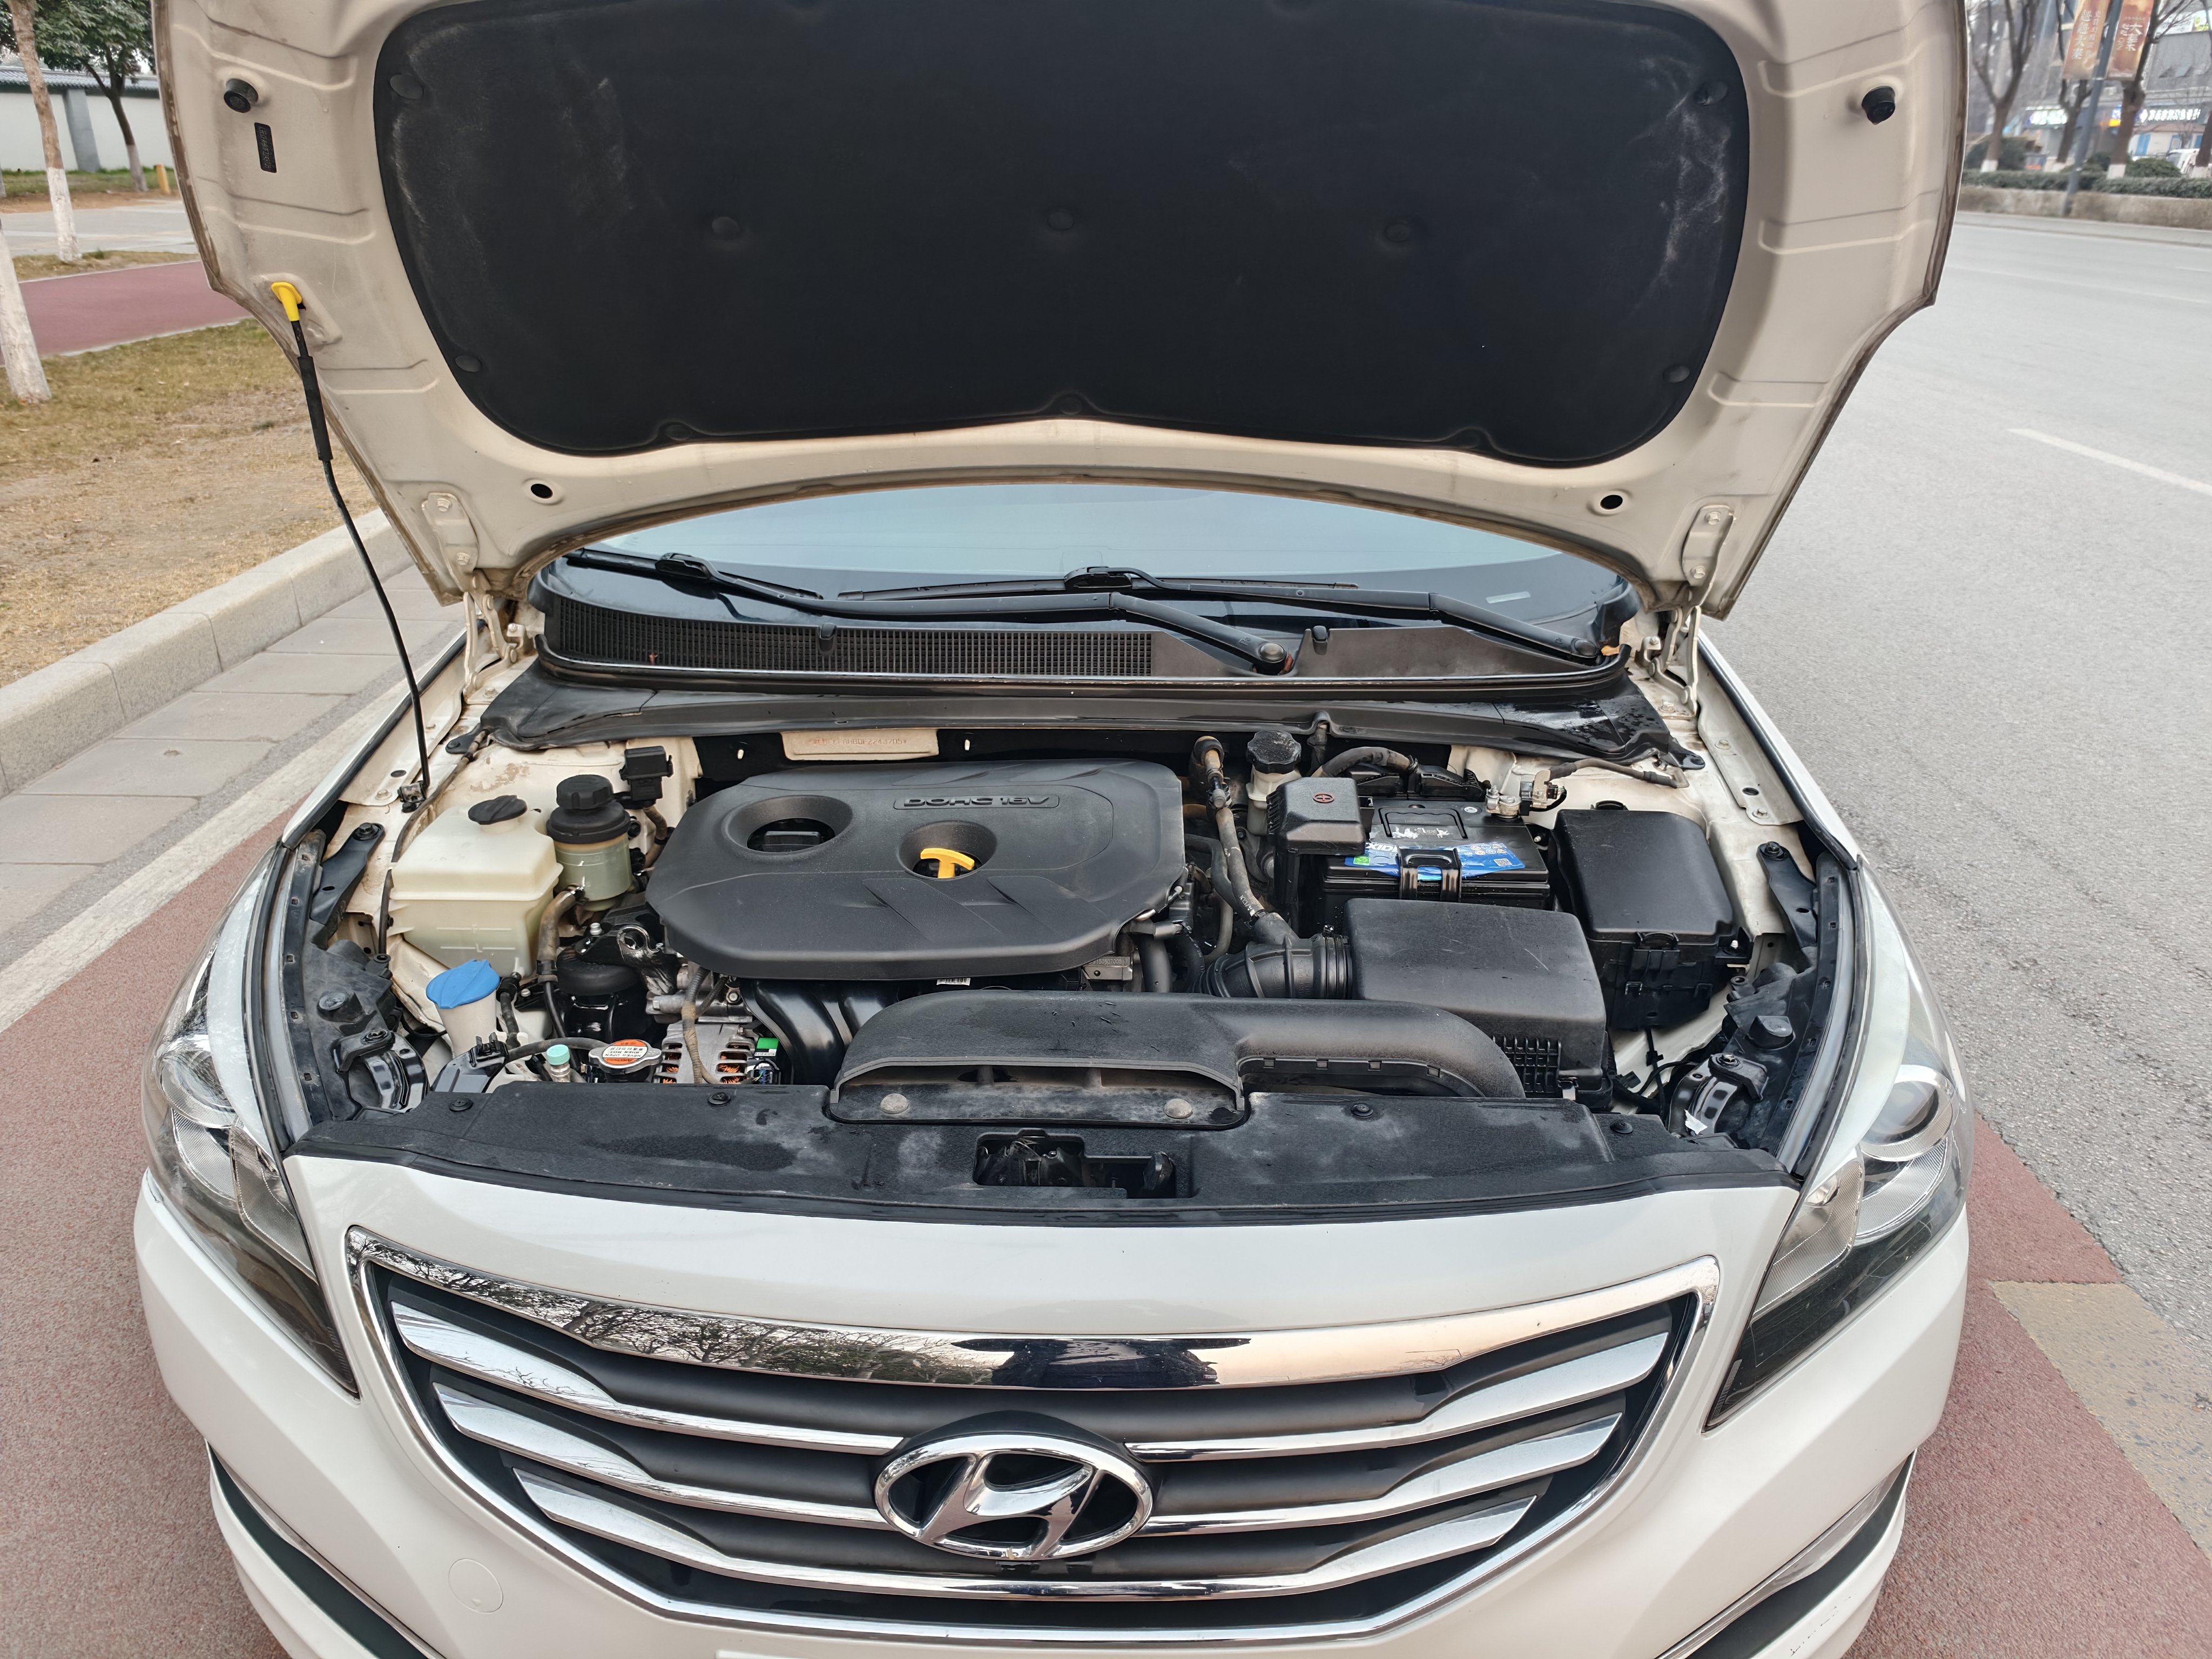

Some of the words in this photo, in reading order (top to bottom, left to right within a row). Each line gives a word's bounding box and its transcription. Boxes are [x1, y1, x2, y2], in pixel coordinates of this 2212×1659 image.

[903, 797, 993, 807] DOHC
[1000, 797, 1050, 805] 16V
[1365, 842, 1398, 853] XID
